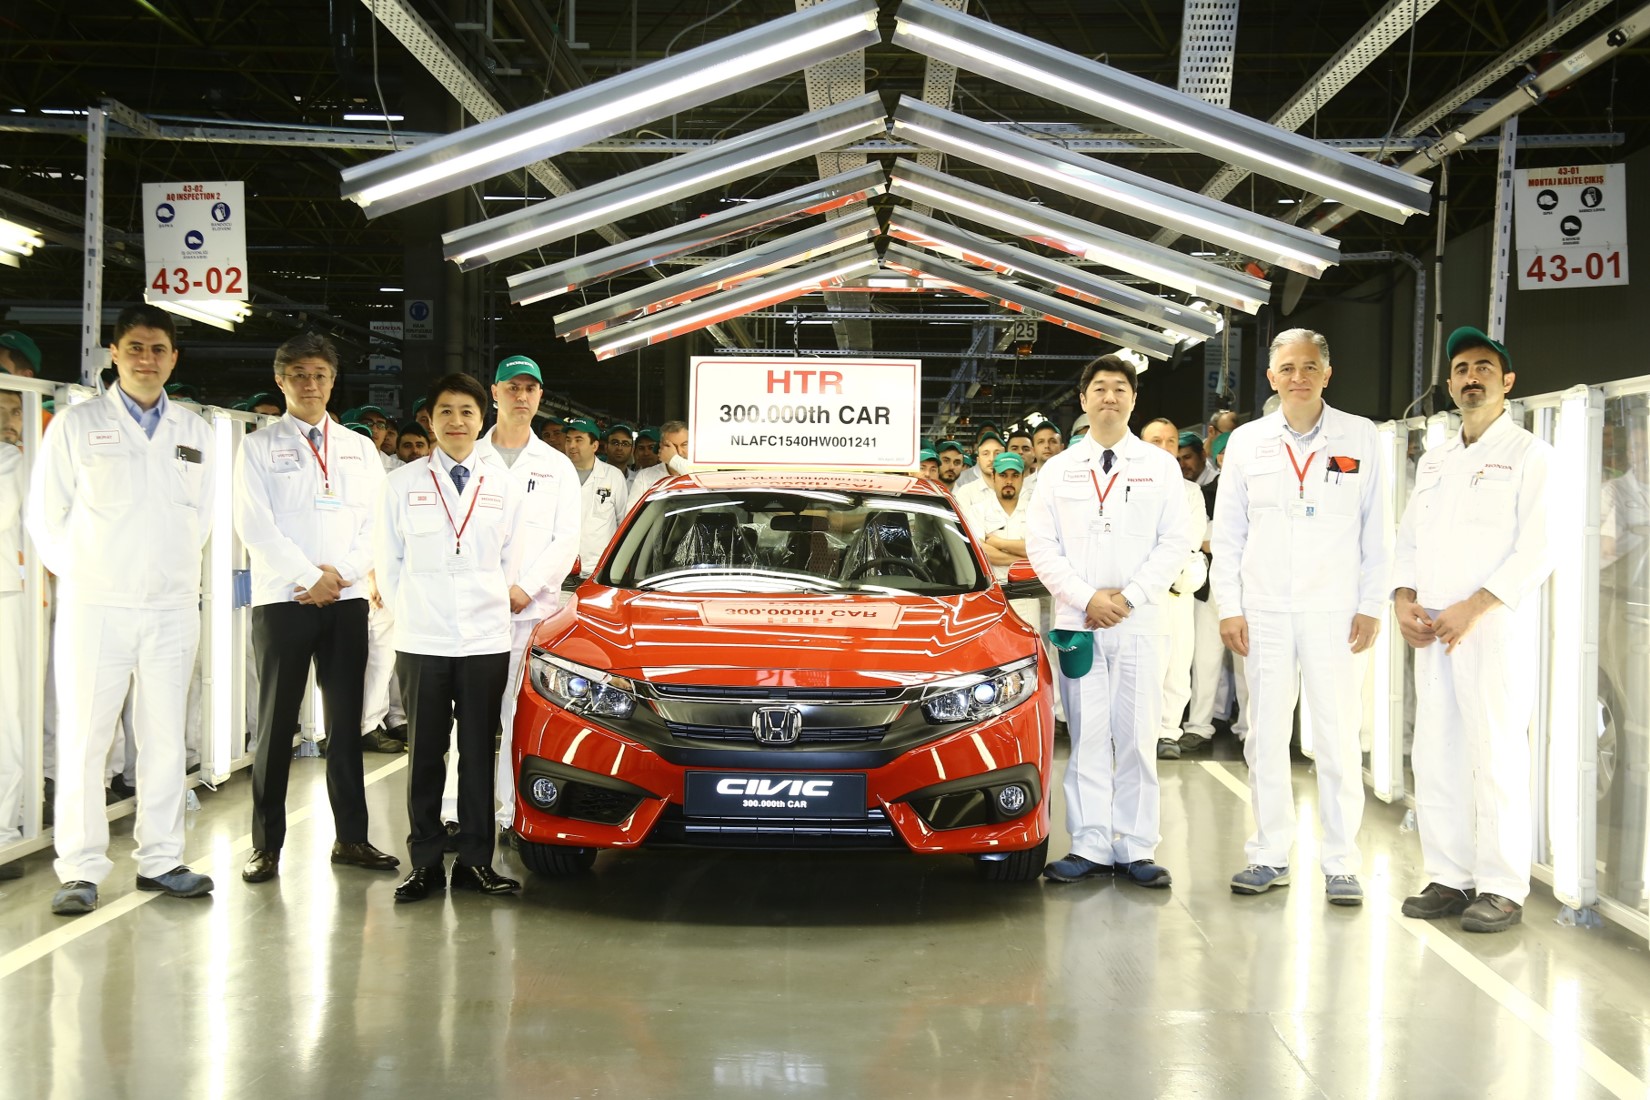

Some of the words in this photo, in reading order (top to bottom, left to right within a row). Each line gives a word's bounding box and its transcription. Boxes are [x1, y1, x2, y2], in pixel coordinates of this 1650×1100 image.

[1558, 167, 1579, 175] 43-01
[1528, 178, 1557, 187] MONTAJ
[166, 193, 175, 201] AQ
[176, 193, 216, 201] INSPECTION
[1526, 251, 1620, 282] 43-01
[152, 267, 242, 294] 43-02
[1016, 322, 1035, 338] 25
[506, 361, 534, 369] HONDA
[767, 369, 844, 395] HTR
[719, 404, 830, 425] 300.000th
[838, 405, 890, 425] CAR
[730, 435, 877, 448] NLAFC1540HW001241
[1485, 463, 1513, 471] HONDA
[716, 778, 834, 797] CIVIC
[742, 799, 785, 808] 300.000th
[787, 800, 807, 808] CAR
